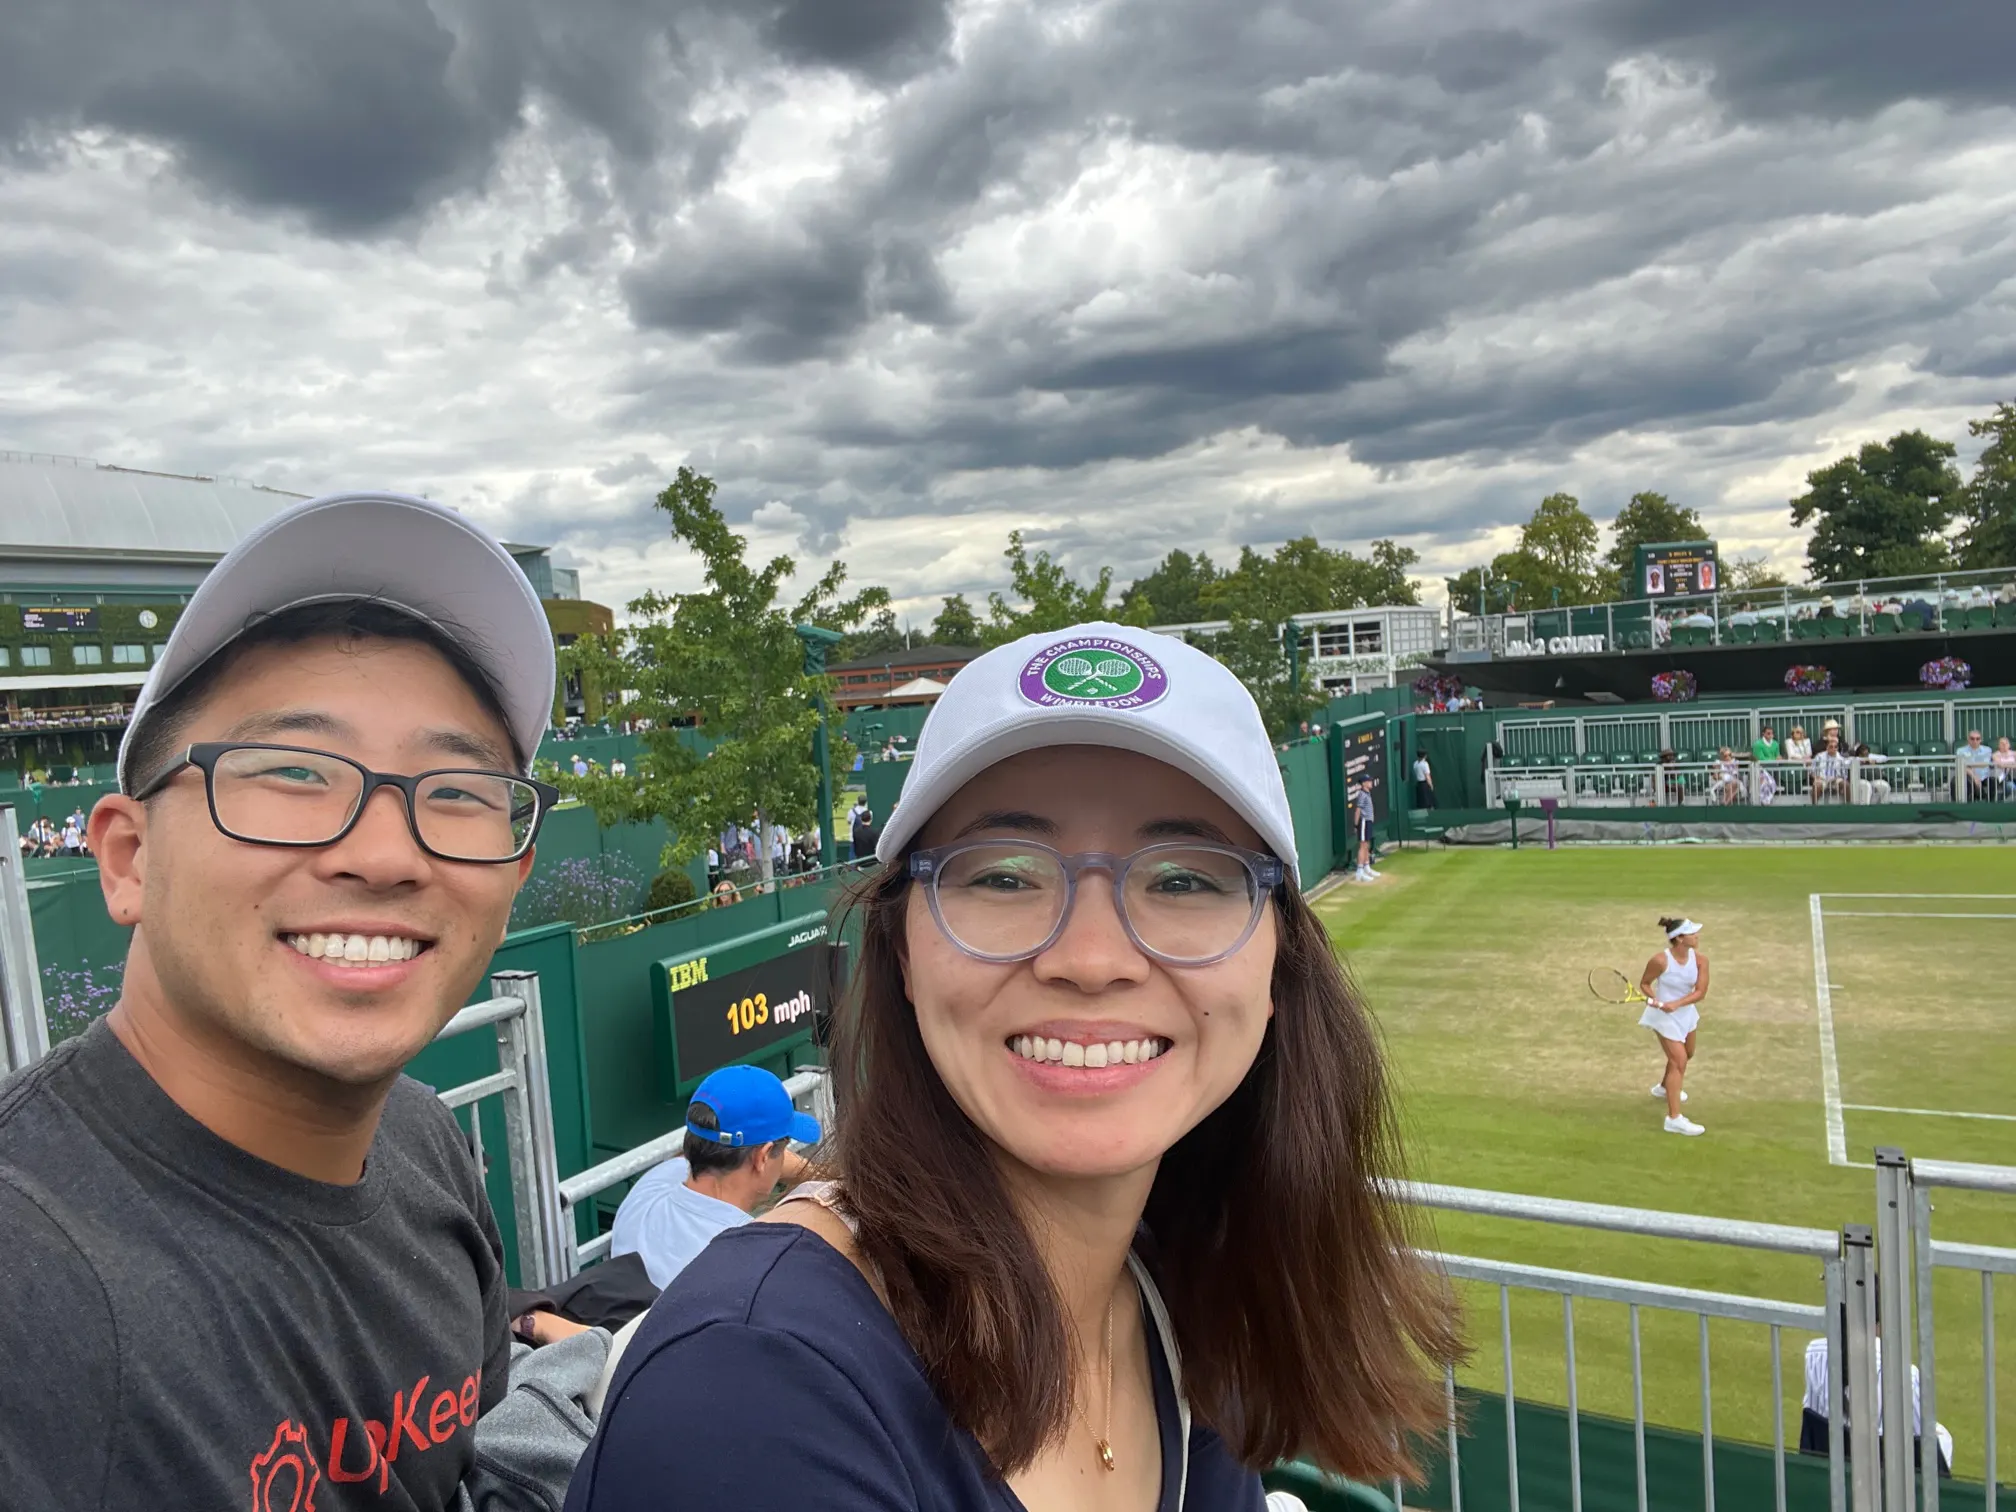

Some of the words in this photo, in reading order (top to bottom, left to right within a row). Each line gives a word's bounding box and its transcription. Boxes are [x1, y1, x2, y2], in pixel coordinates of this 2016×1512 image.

[1026, 655, 1050, 677] THE
[1045, 638, 1162, 681] CHAMPIONSHIPS
[1549, 633, 1605, 655] COURT
[669, 956, 709, 993] IBM
[726, 992, 769, 1036] 103
[773, 989, 811, 1025] mph
[327, 1367, 482, 1496] UpKee
